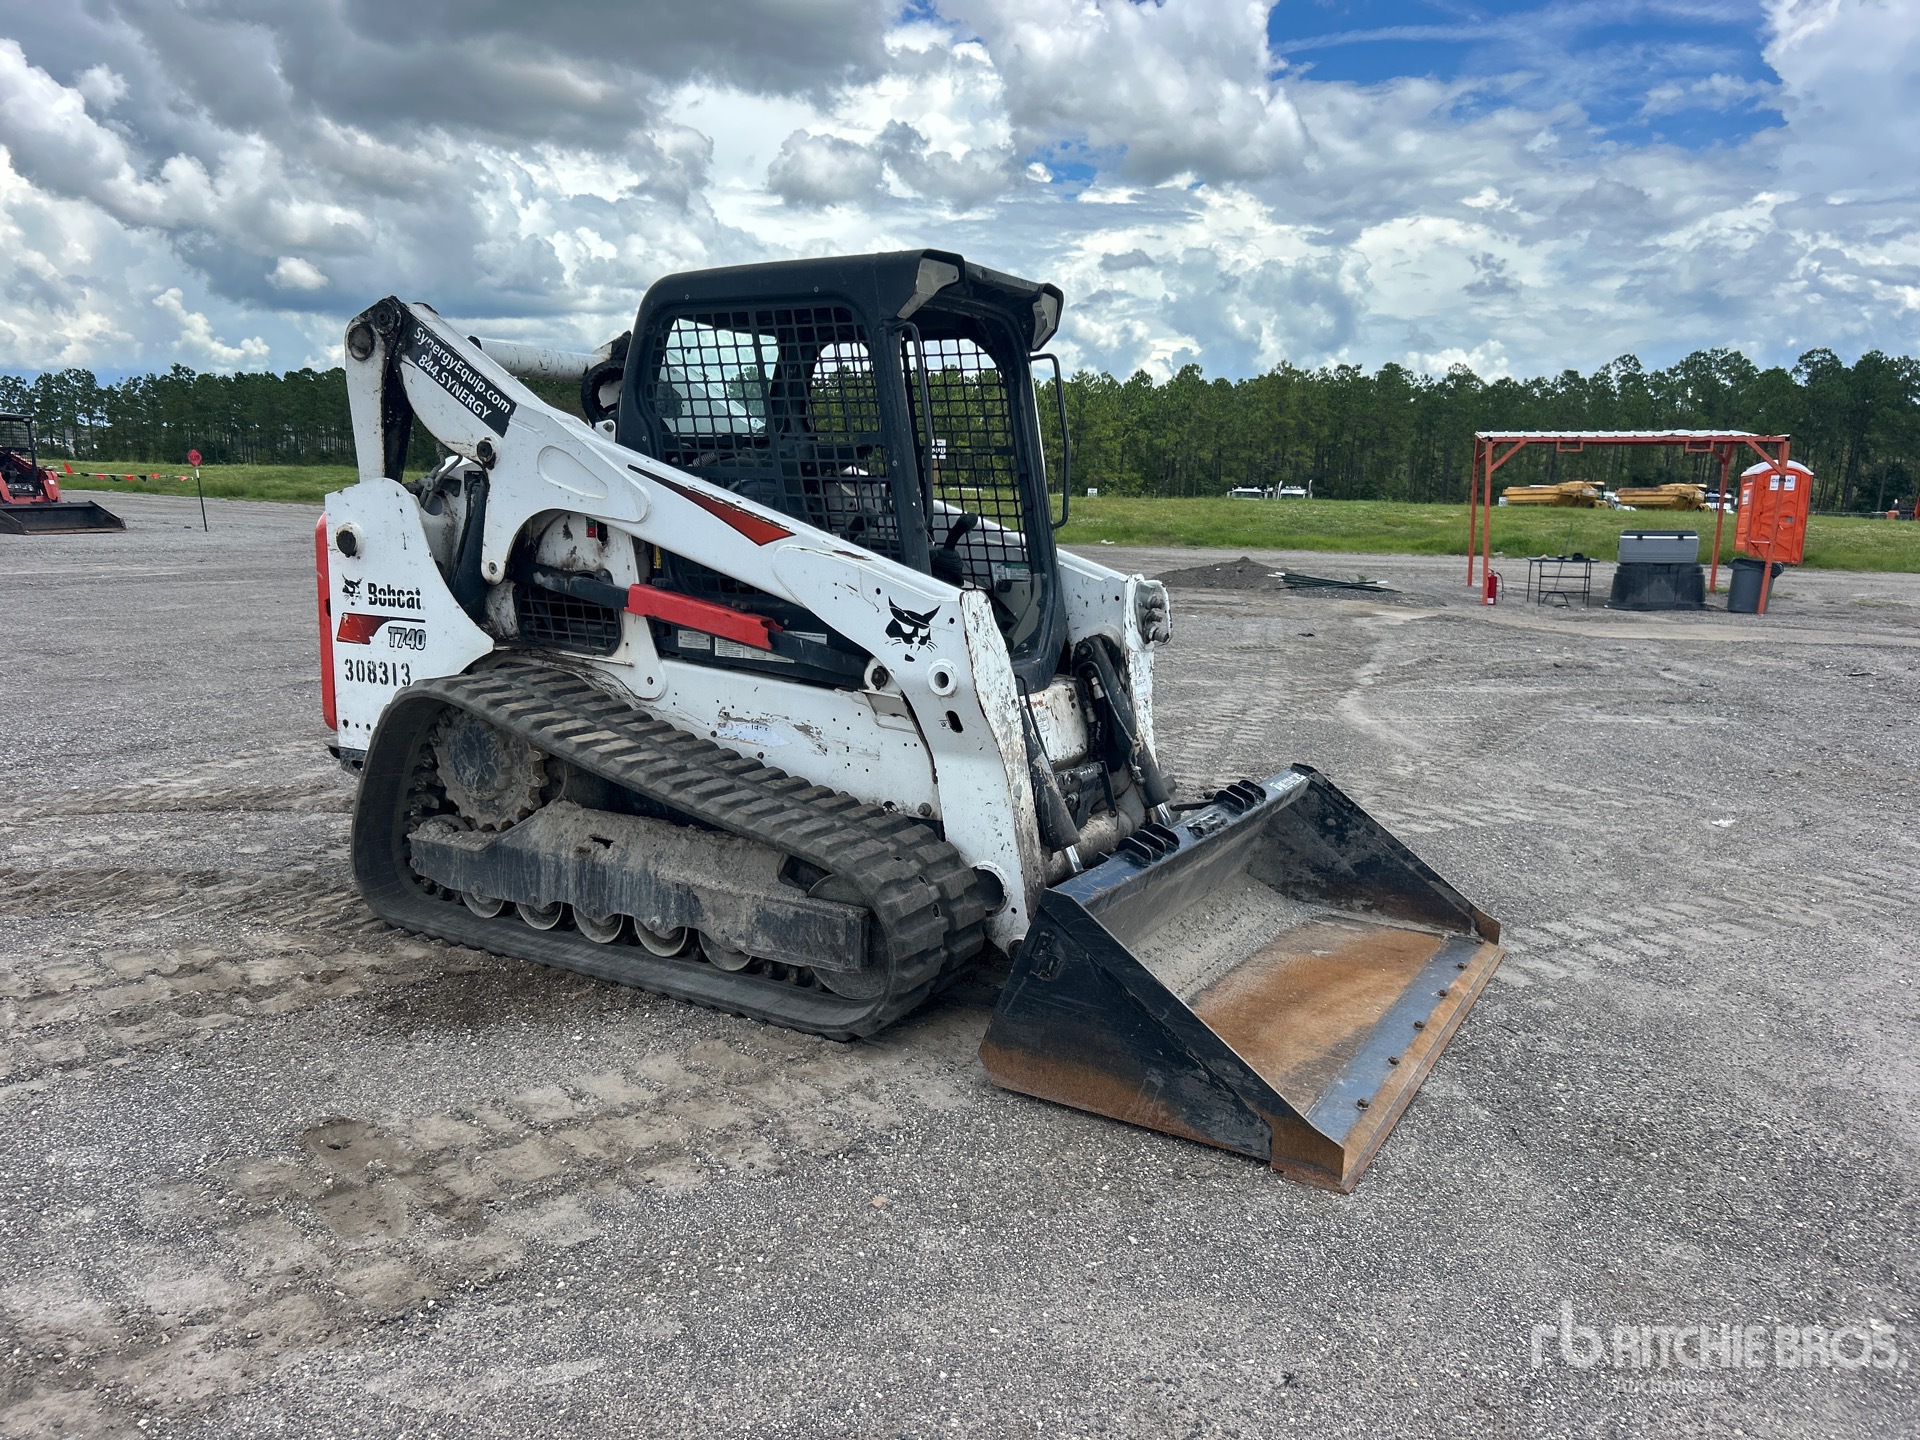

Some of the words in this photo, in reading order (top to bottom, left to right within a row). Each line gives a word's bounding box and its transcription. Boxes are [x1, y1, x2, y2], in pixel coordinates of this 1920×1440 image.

[413, 327, 511, 413] SynergyEquip.com
[418, 355, 492, 419] 844.SYNERGY
[367, 582, 421, 610] Bobcat
[387, 626, 426, 651] T740
[344, 658, 411, 686] 308313
